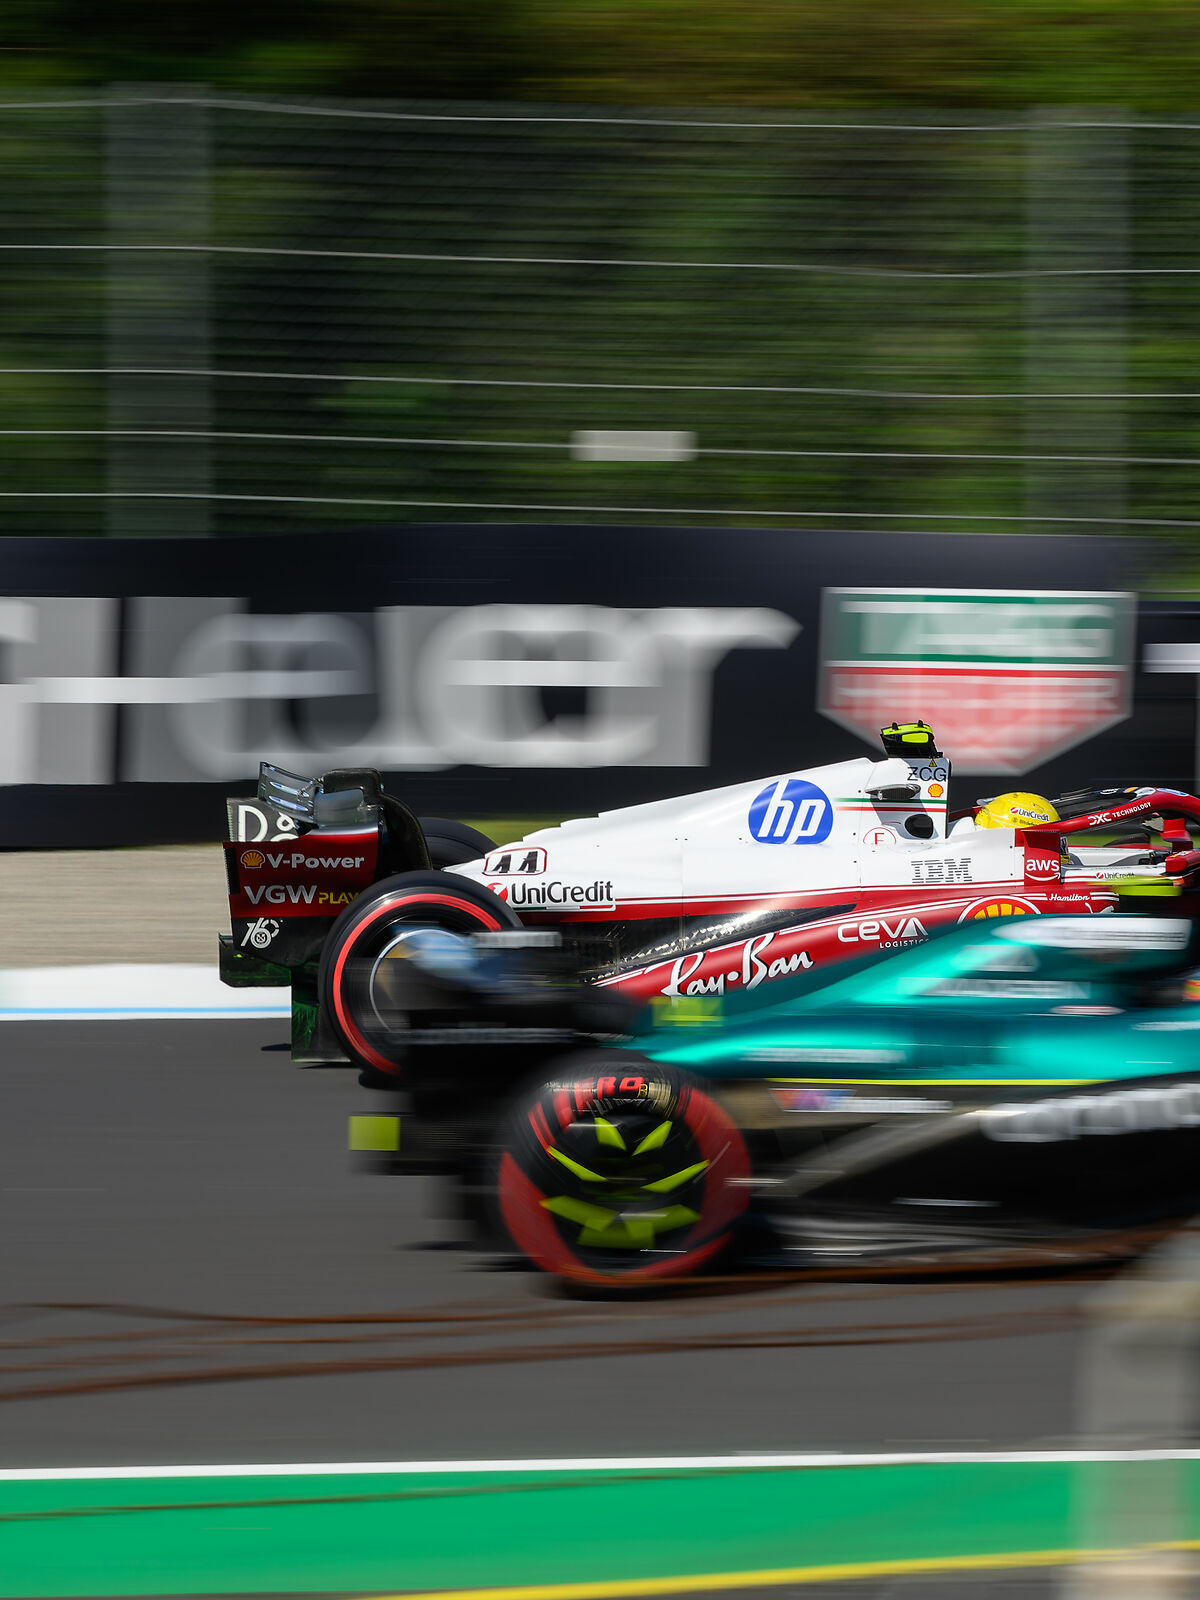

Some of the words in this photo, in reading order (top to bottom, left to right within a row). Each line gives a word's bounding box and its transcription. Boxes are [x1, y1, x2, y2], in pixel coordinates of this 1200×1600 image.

[907, 767, 947, 782] ZCG
[758, 780, 821, 844] hp
[1088, 812, 1112, 826] DXC
[1112, 801, 1152, 818] TECHNOLOGY
[267, 853, 365, 869] V-Power
[1026, 858, 1060, 872] aws
[911, 858, 972, 884] IBM
[244, 885, 317, 905] VGW
[511, 881, 614, 905] UniCredit
[1049, 893, 1091, 902] Hamilton
[879, 939, 929, 949] LOGISTI
